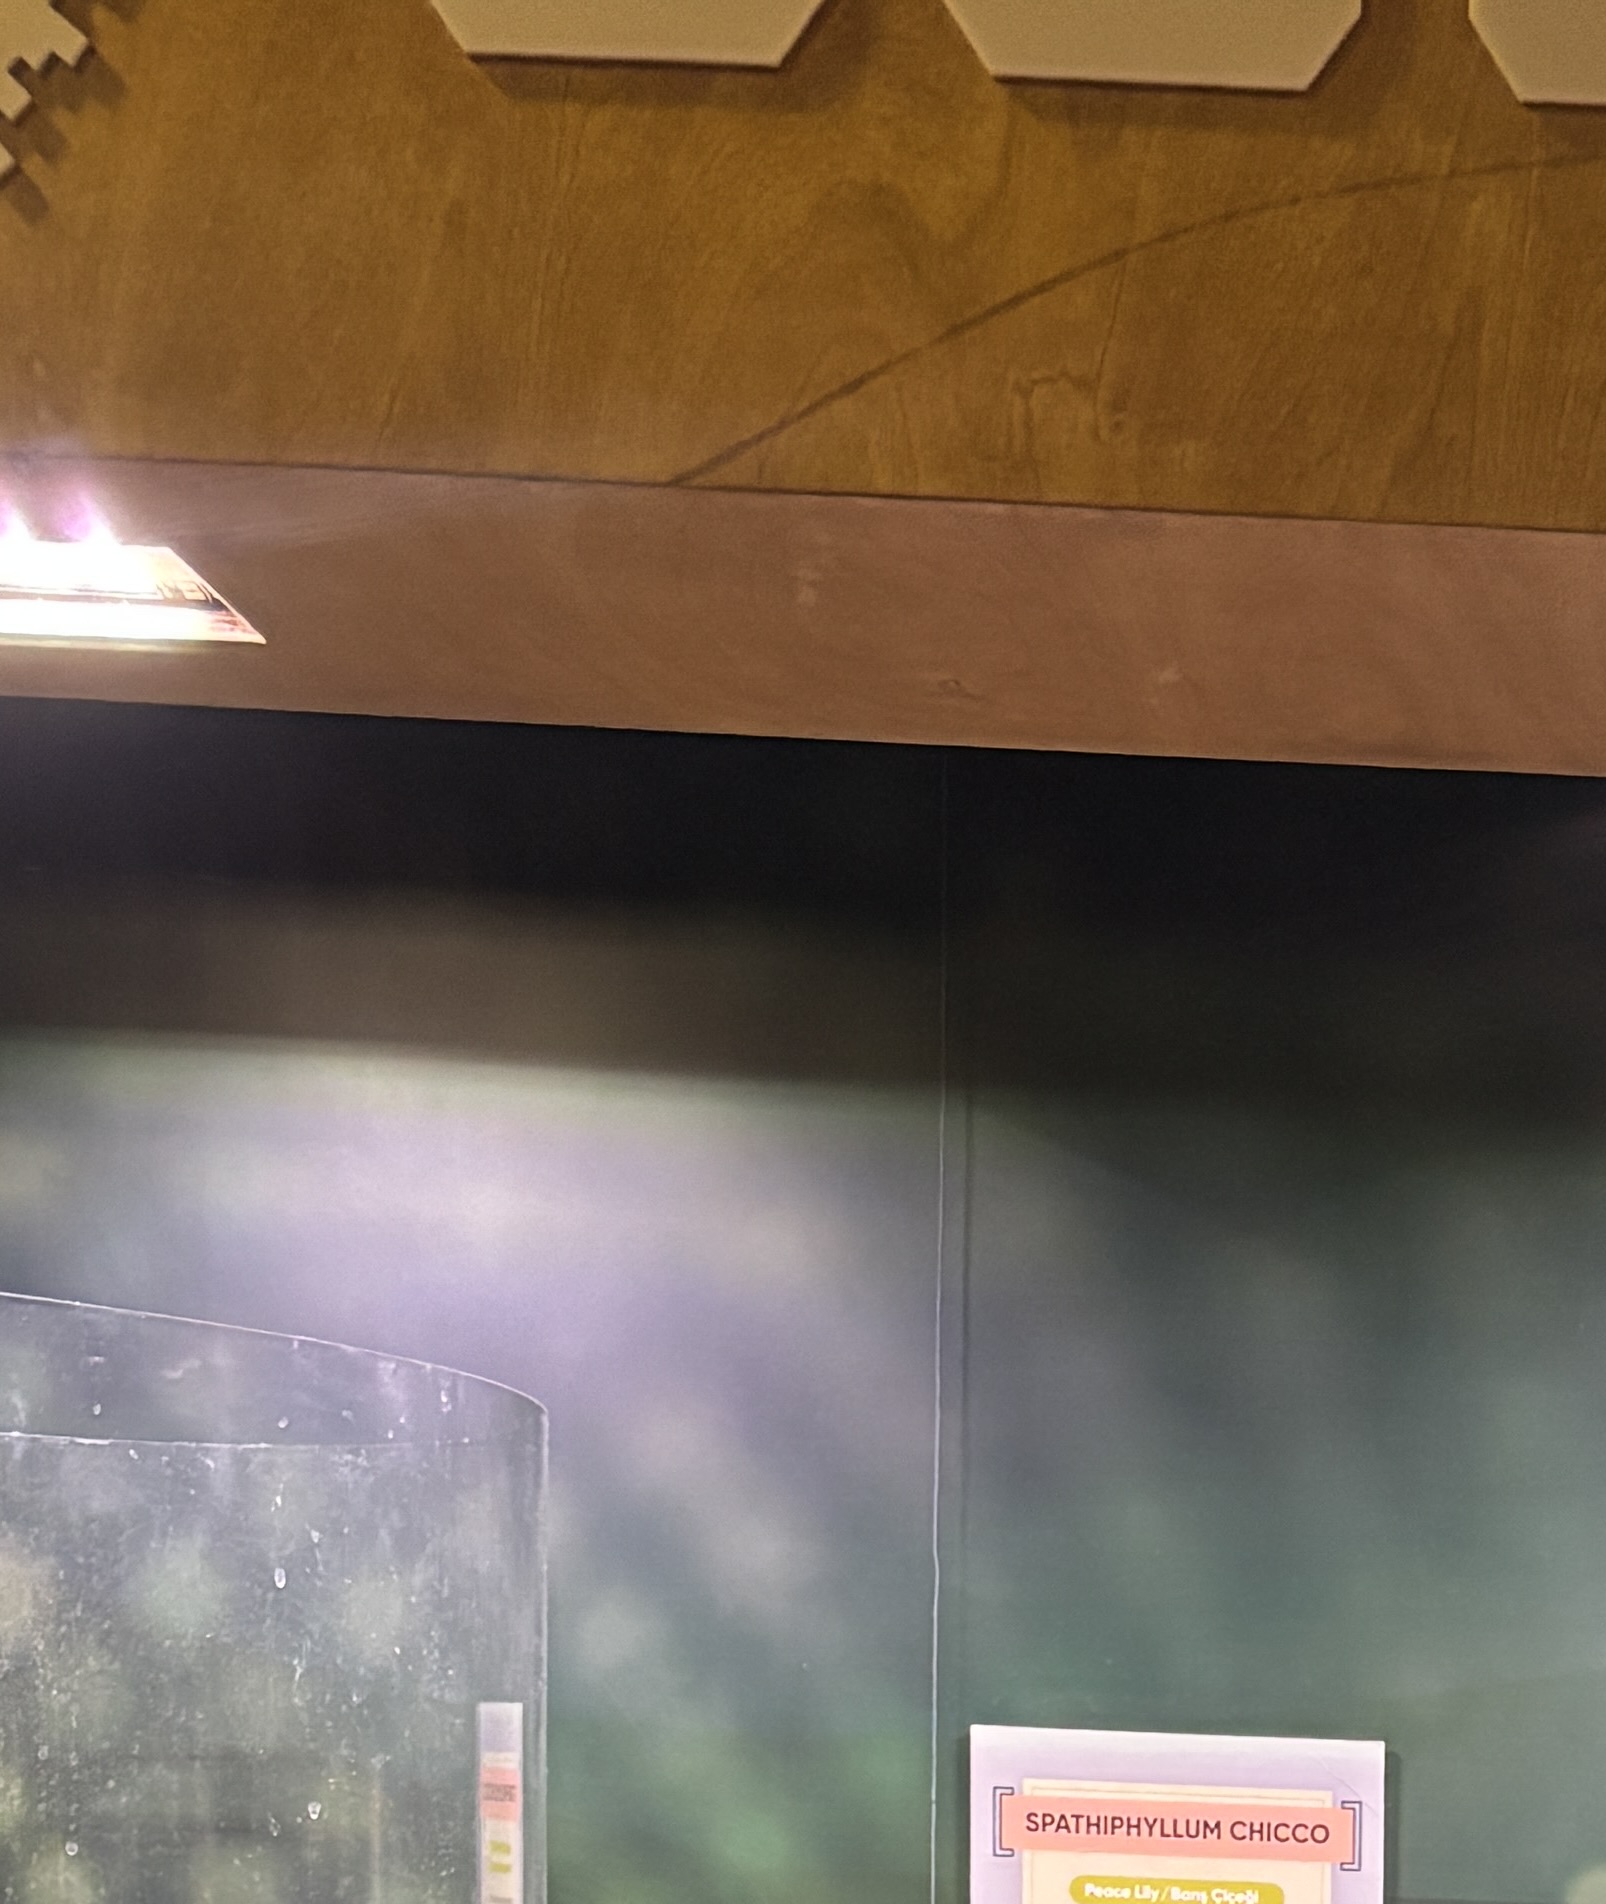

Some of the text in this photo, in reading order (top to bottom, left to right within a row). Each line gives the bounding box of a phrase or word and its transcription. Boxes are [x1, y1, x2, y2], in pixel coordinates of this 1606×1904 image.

[1025, 1812, 1330, 1845] SPATHIPHYLLUM CHICCO
[1084, 1882, 1131, 1899] Peace
